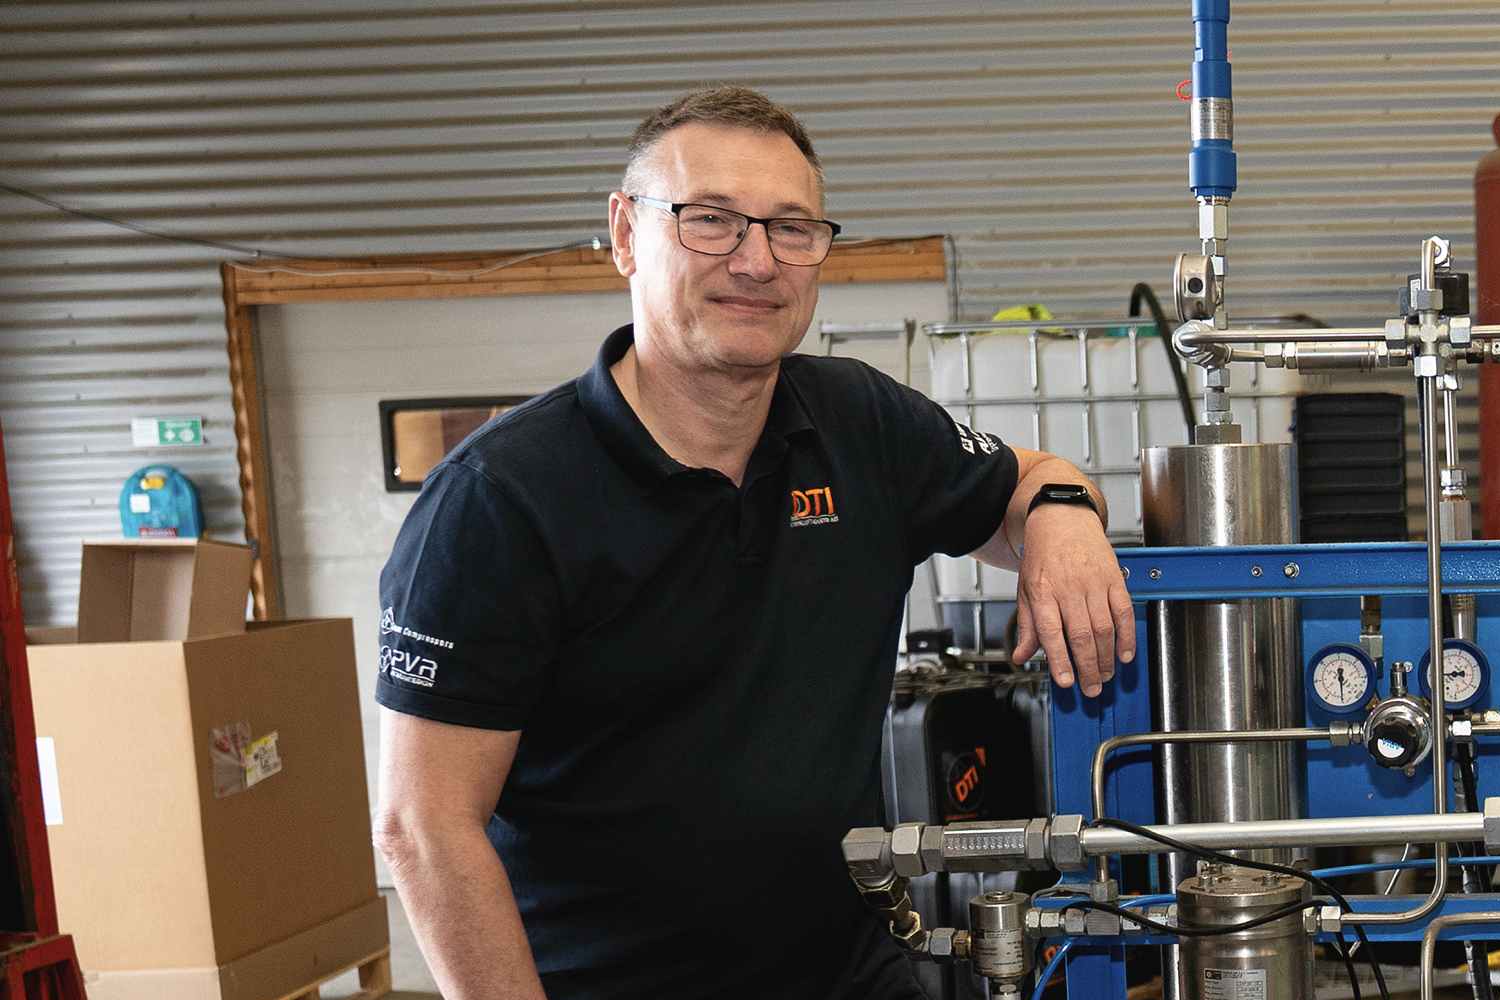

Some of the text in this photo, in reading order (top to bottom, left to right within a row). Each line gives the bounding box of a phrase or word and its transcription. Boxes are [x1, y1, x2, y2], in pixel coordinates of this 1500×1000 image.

[791, 487, 835, 518] DTI
[391, 649, 438, 679] PVR
[955, 765, 979, 803] DTI
